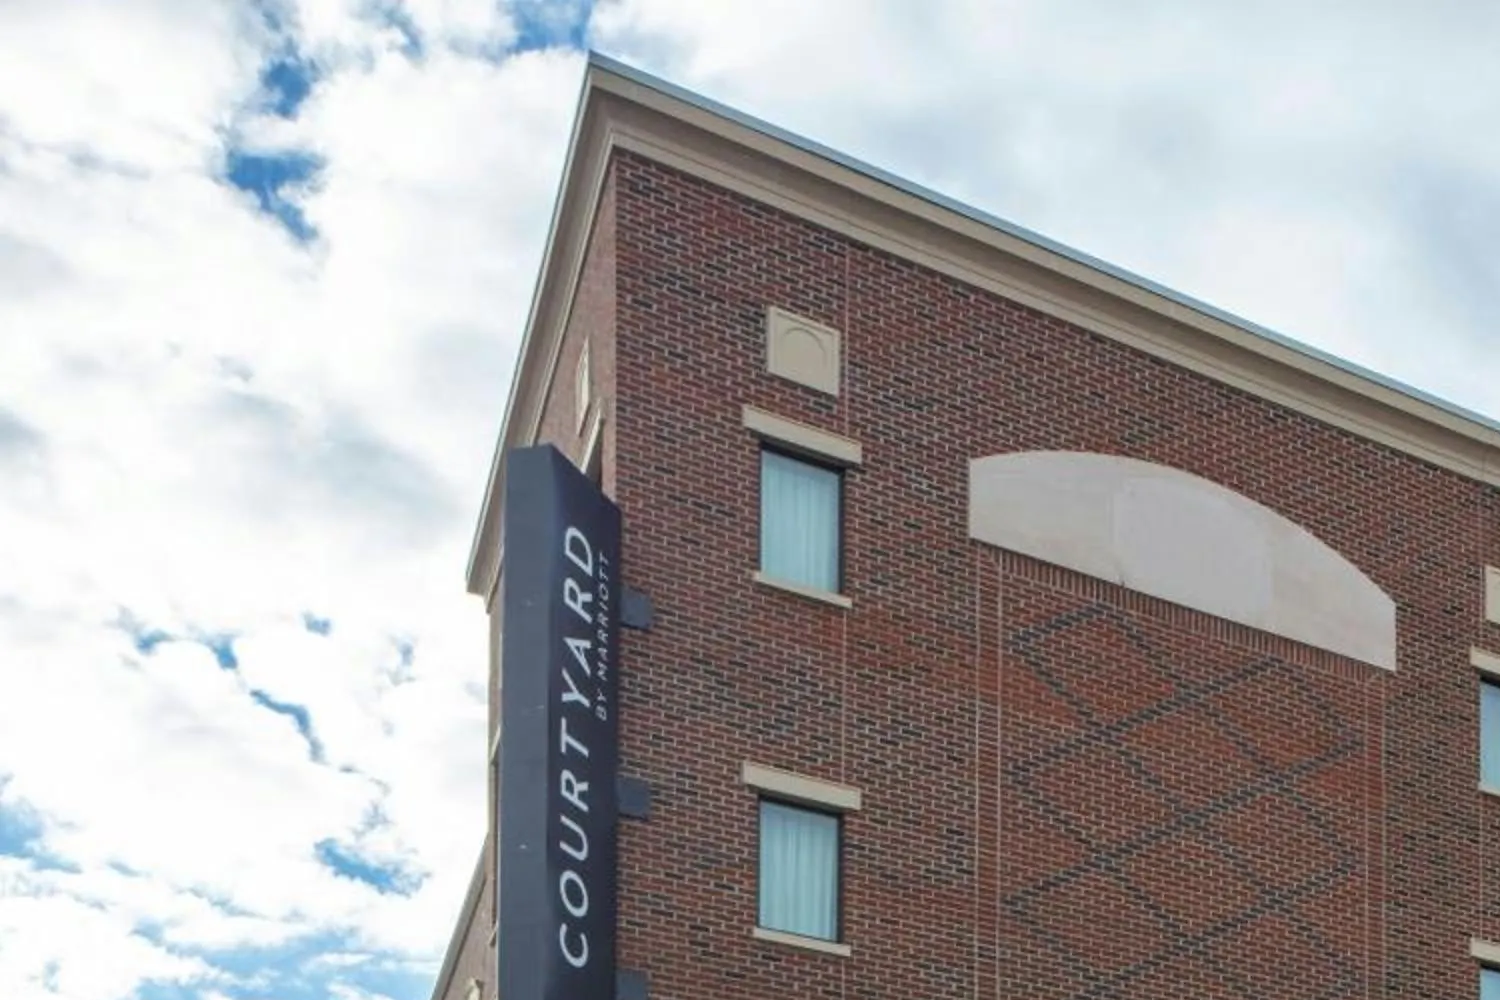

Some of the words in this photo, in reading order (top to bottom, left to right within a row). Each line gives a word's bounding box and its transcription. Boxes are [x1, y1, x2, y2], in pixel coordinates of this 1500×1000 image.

[597, 552, 610, 682] MARRIOTT
[559, 524, 594, 968] COURTYARD
[595, 688, 608, 721] BY
